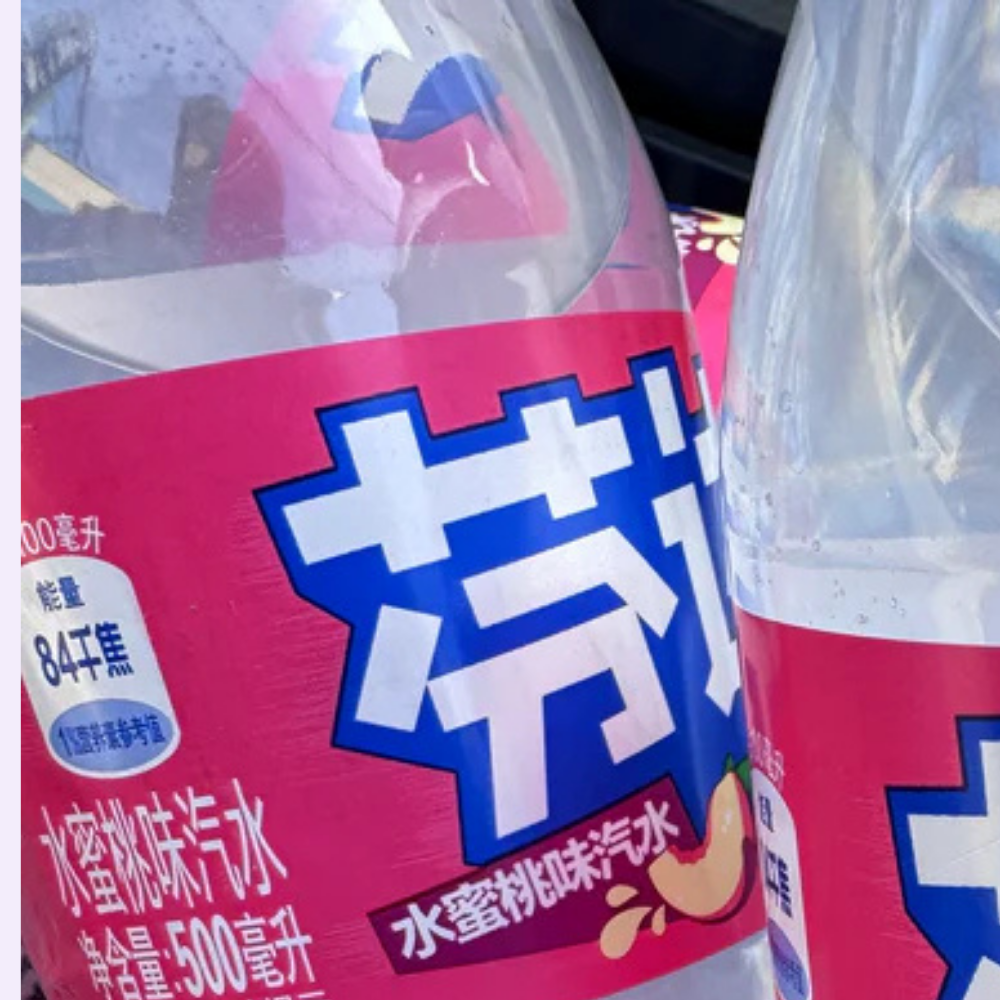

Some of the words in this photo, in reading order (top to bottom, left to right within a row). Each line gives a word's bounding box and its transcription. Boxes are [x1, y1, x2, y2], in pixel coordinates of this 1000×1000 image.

[36, 575, 85, 612] 能量
[34, 621, 134, 687] 84千焦
[40, 777, 288, 918] 水蜜桃味汽水
[391, 799, 680, 960] 水蜜桃味汽水
